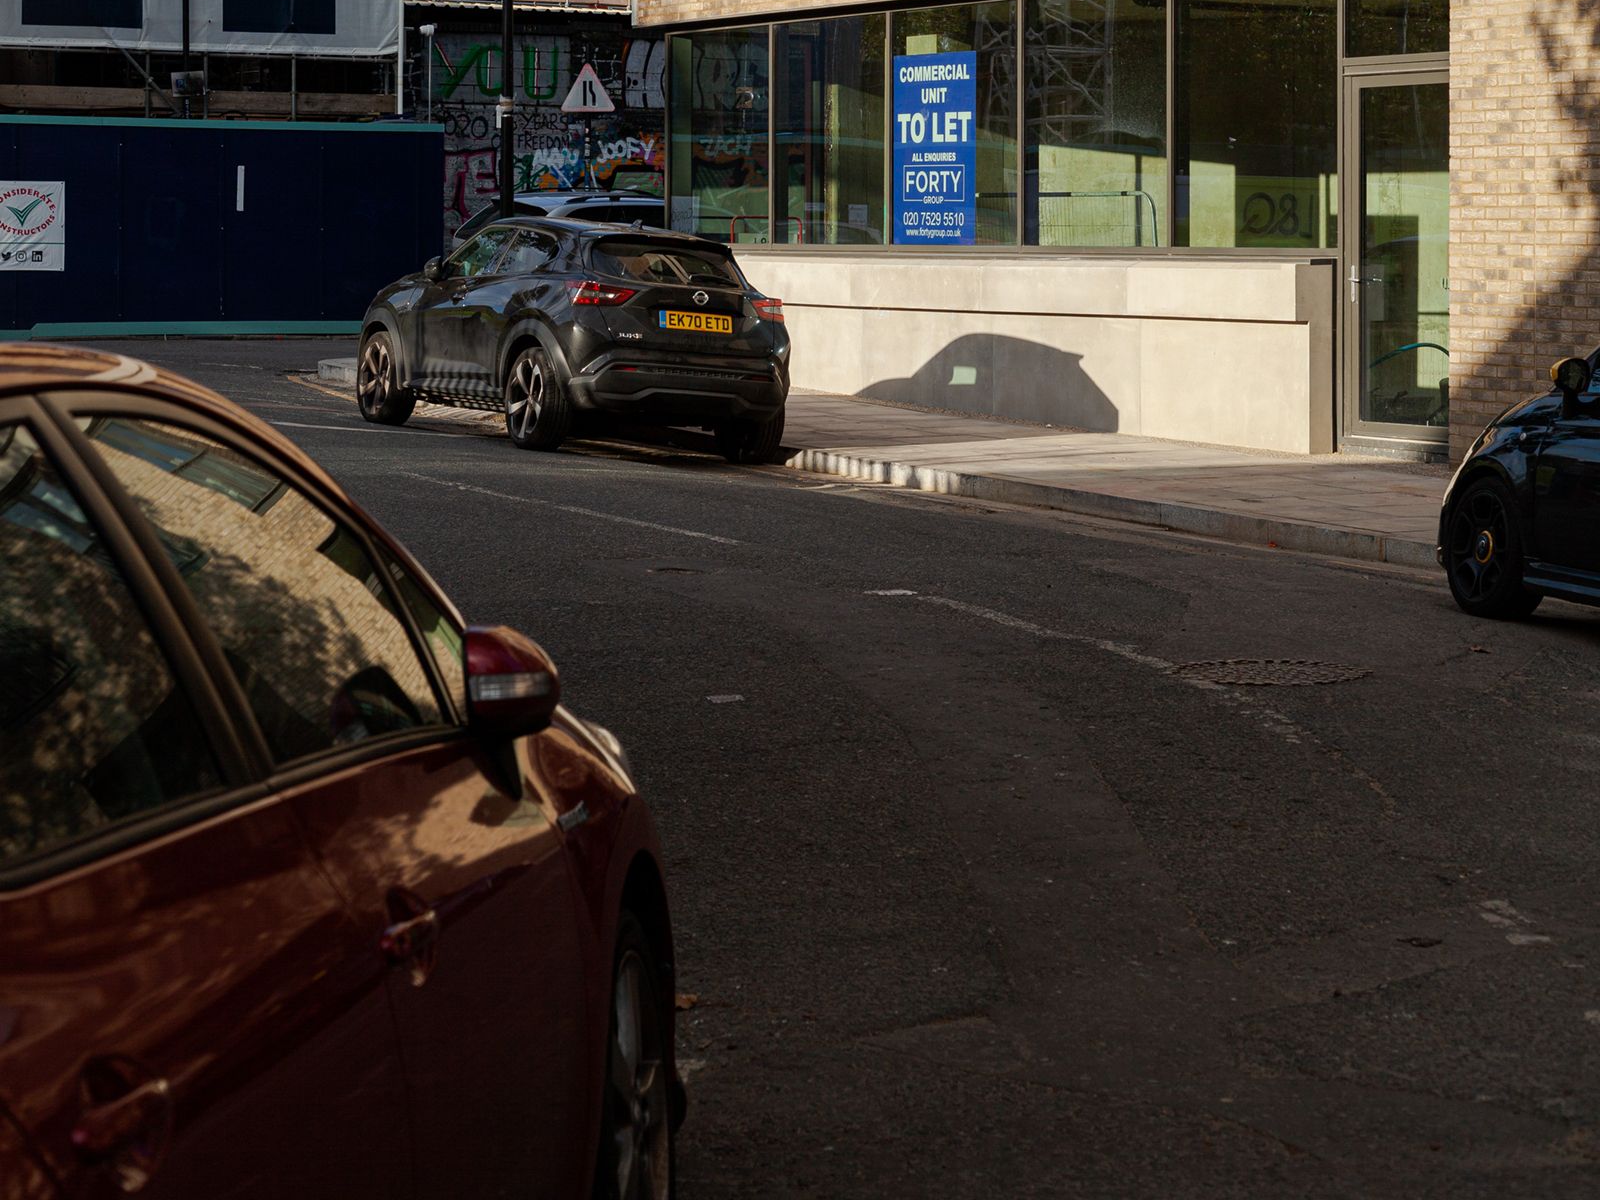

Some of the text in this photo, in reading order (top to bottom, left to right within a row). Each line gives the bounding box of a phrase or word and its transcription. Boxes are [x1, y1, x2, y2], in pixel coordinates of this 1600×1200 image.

[899, 63, 970, 83] COMMERCIAL
[921, 87, 948, 105] UNIT
[520, 112, 569, 131] YEARS
[897, 111, 972, 144] TO LET
[911, 151, 957, 162] ALL ENQUIRIES
[905, 170, 962, 193] FORTY
[922, 195, 944, 204] GROUP
[903, 211, 964, 226] 020 7529 5510
[906, 227, 961, 239] www.fortygroup.co.uk
[668, 313, 730, 331] EK70 ETD
